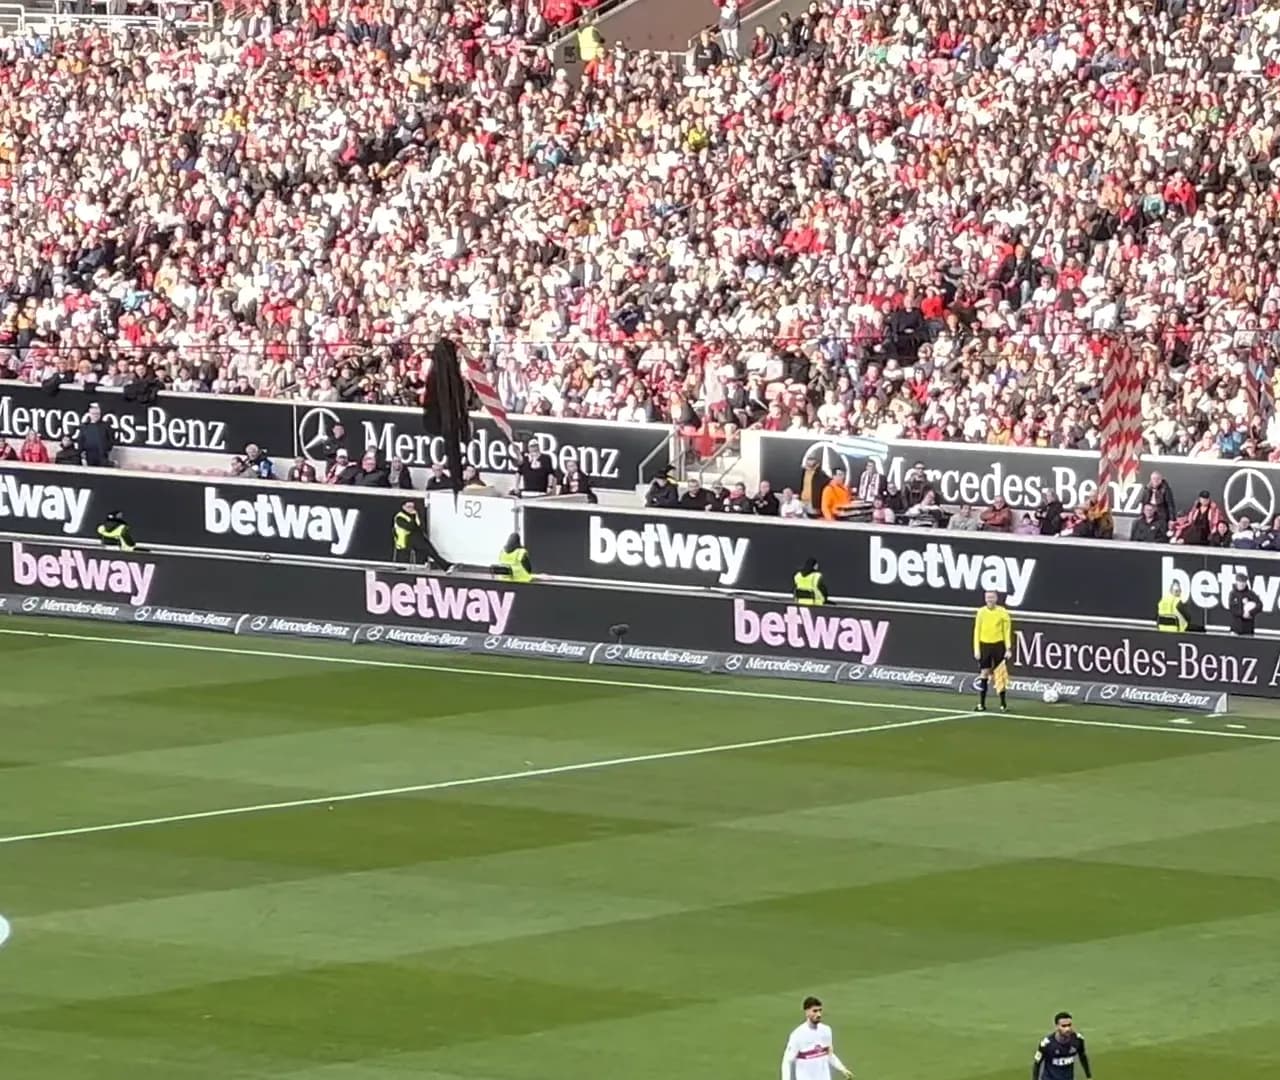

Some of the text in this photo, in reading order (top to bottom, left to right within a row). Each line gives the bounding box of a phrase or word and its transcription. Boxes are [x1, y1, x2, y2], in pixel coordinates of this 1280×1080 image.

[204, 486, 358, 555] betway
[464, 503, 482, 519] 52
[13, 542, 155, 607] betway
[590, 515, 749, 585] betway
[869, 536, 1036, 606] betway
[365, 570, 515, 635] betway
[733, 599, 889, 665] betway
[1014, 630, 1257, 686] Mercedes-Benz
